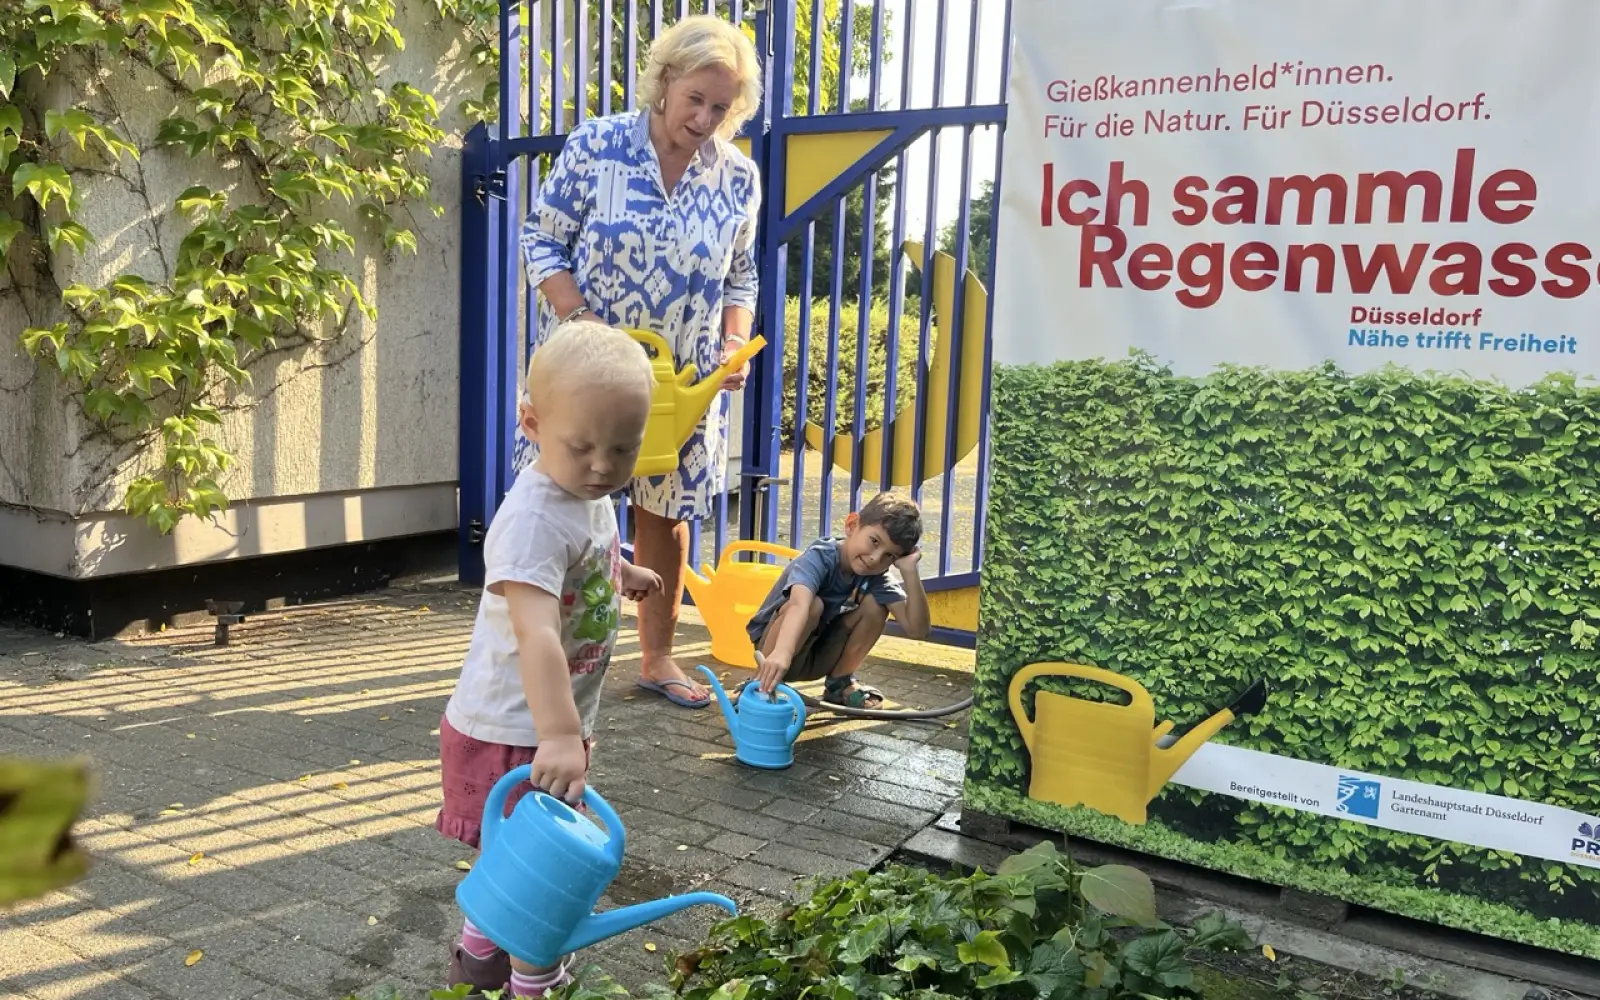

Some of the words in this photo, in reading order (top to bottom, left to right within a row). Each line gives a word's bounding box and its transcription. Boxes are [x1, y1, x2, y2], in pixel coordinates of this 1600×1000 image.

[1044, 115, 1087, 138] Für
[1095, 113, 1134, 138] die
[1144, 109, 1231, 134] Natur.
[1243, 105, 1291, 131] Für
[1301, 92, 1491, 127] Düsseldorf.
[1041, 161, 1150, 226] Ich
[1172, 148, 1537, 226] sammle
[1079, 224, 1600, 309] Regenwass
[1350, 306, 1482, 326] Düsseldorf
[1348, 329, 1409, 348] Nähe
[1415, 330, 1471, 350] trifft
[1479, 332, 1577, 354] Freiheit
[1230, 781, 1298, 803] Bereitgestellt
[1300, 797, 1320, 807] von
[1392, 790, 1482, 815] Landeshauptstadt
[1485, 806, 1544, 825] Düsseldorf
[1390, 803, 1447, 821] Gartenamt
